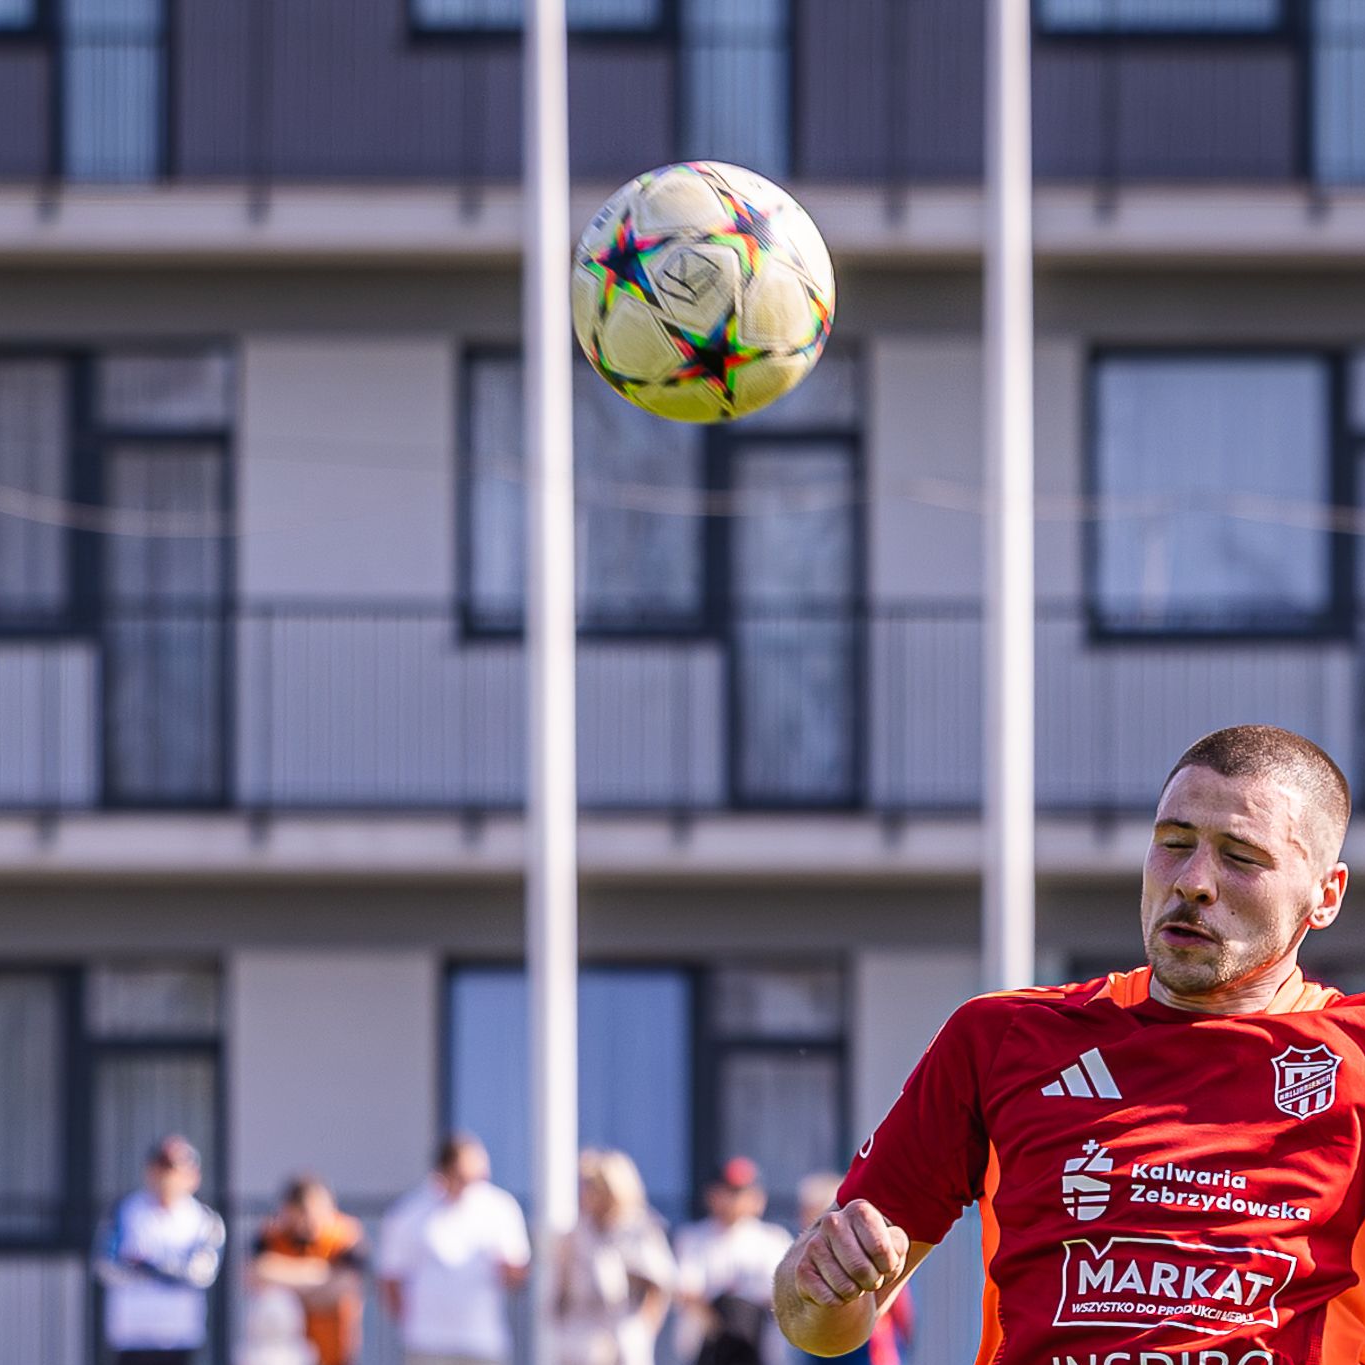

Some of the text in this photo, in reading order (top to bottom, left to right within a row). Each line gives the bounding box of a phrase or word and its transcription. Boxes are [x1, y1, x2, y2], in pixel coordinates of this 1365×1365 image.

[1131, 1163, 1247, 1189] Kalwaria
[1130, 1184, 1310, 1221] Zebrzydowska
[1077, 1259, 1274, 1306] MARKAT
[1071, 1301, 1135, 1314] WSZYSTKO
[1136, 1303, 1156, 1315] DO
